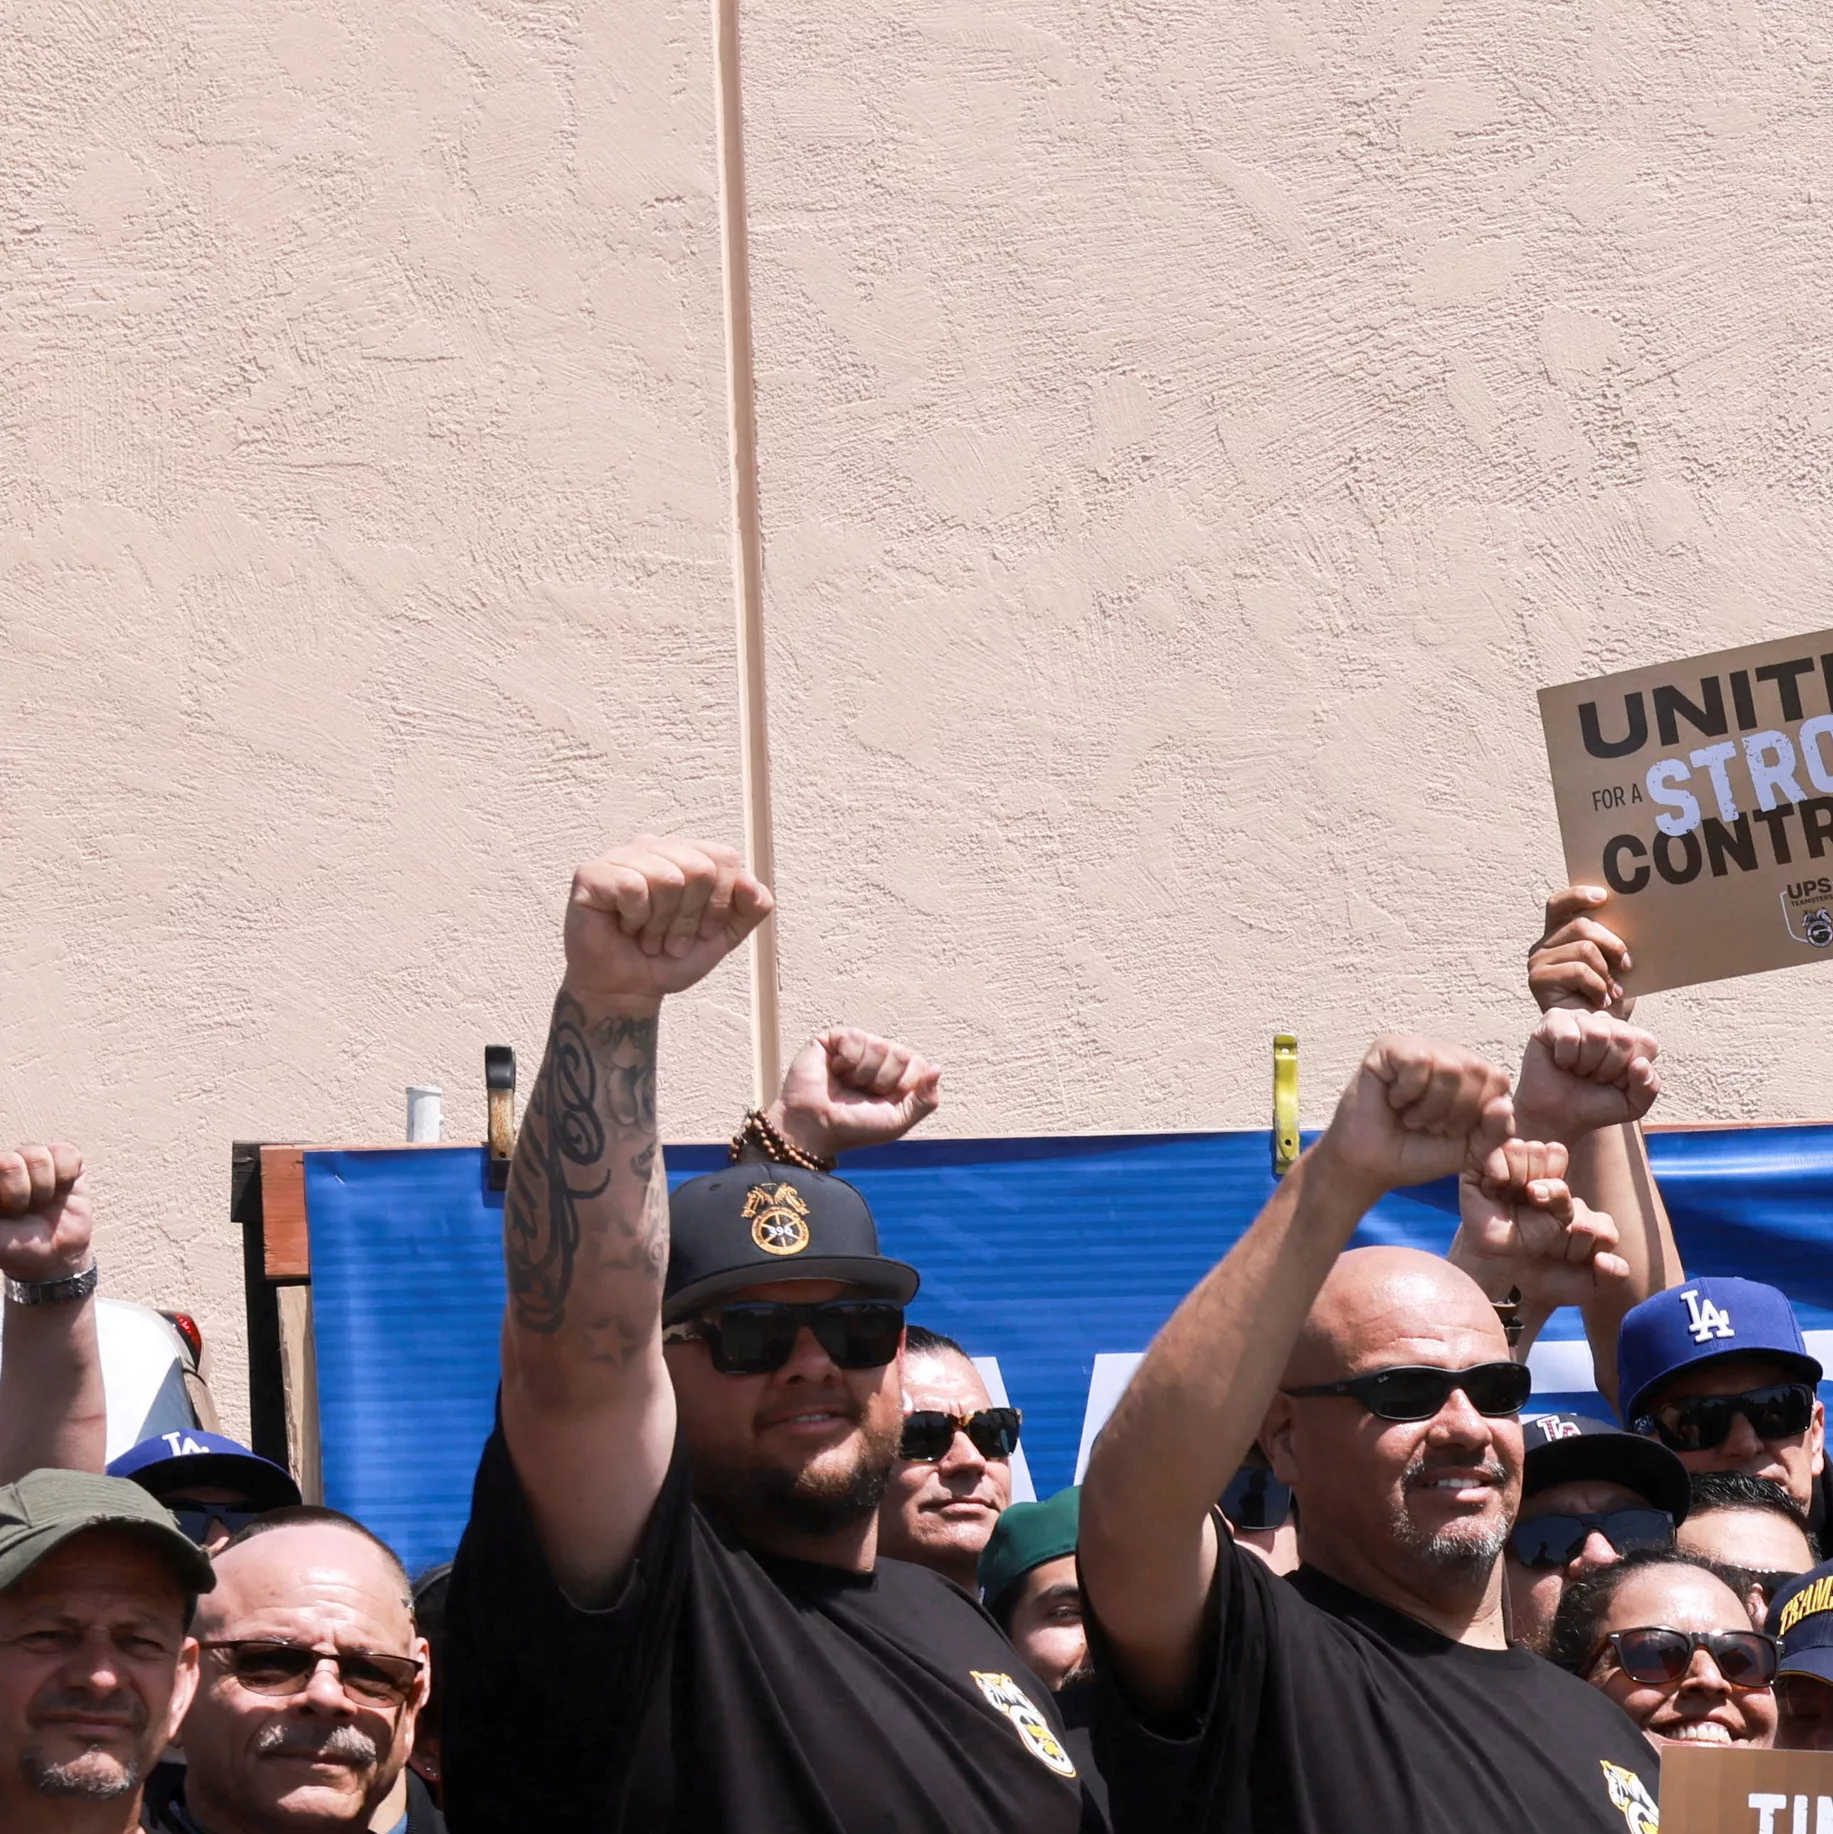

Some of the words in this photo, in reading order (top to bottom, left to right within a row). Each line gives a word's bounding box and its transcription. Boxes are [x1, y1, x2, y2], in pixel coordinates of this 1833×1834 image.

[1592, 786, 1626, 812] FOR
[1631, 783, 1643, 804] A
[1787, 877, 1833, 900] UPS
[1680, 1290, 1734, 1342] LA
